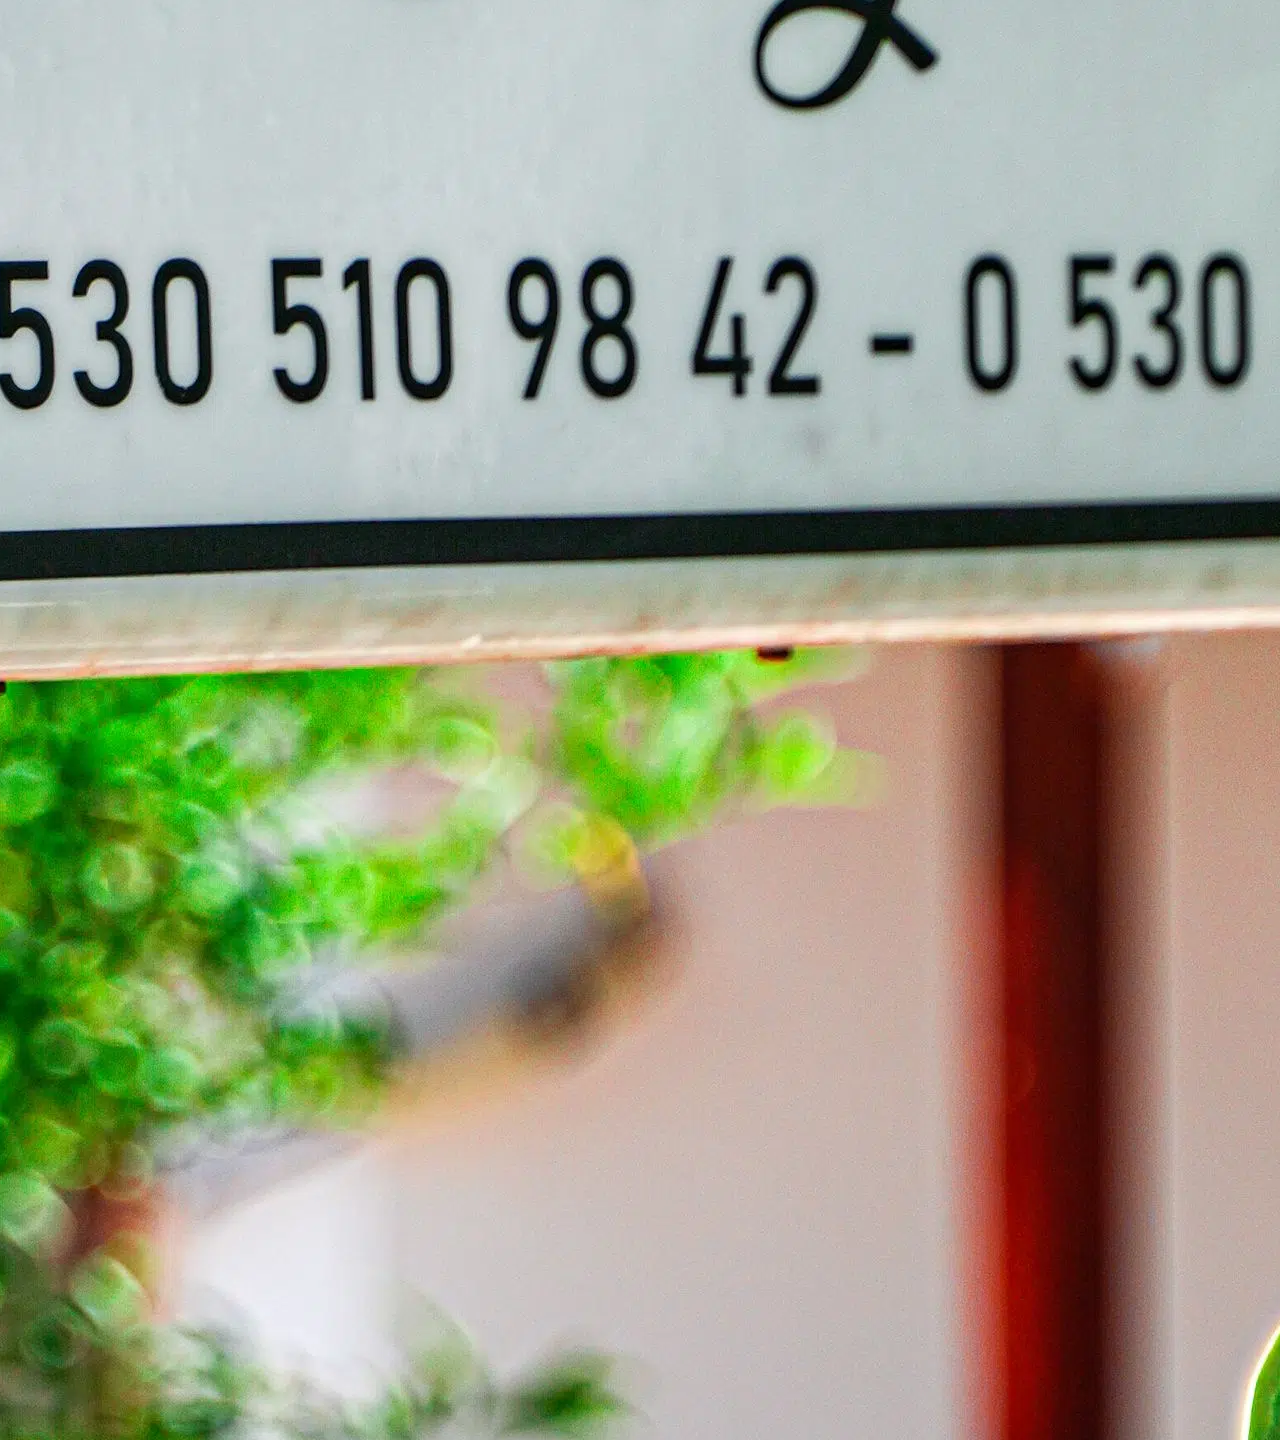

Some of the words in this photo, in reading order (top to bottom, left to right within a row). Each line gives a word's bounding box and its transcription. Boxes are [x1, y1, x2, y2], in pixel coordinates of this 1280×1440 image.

[269, 256, 455, 406] 510
[505, 255, 639, 402] 98
[690, 254, 823, 399] 42
[962, 252, 1020, 396] 0
[1066, 250, 1252, 395] 530
